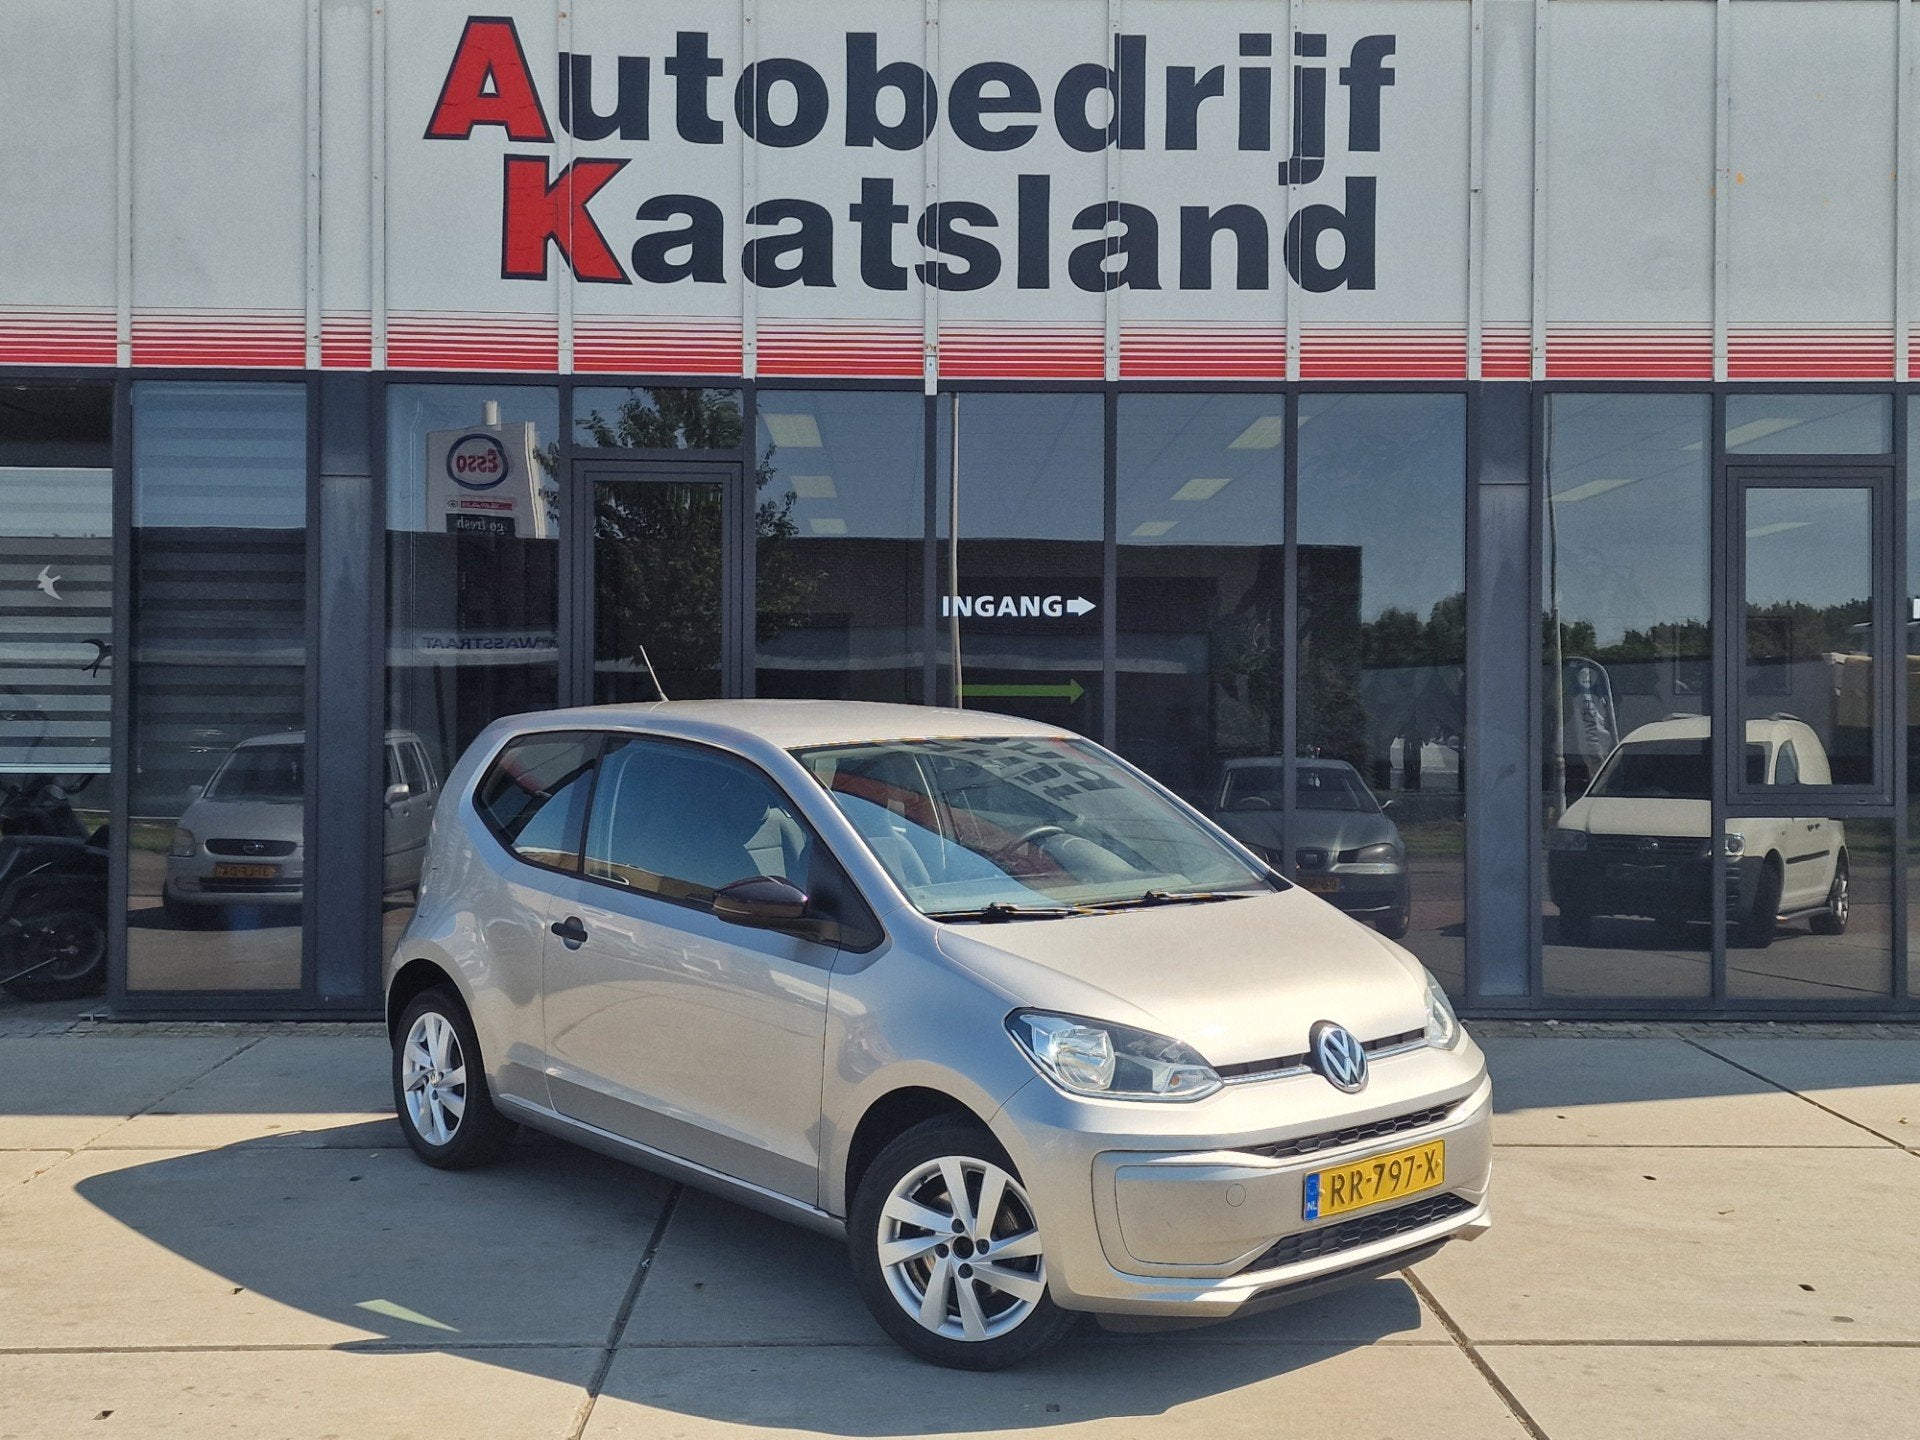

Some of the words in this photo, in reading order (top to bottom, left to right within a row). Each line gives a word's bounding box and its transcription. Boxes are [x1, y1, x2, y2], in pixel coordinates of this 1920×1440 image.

[423, 16, 1396, 186] Autobedrijf
[501, 153, 1377, 293] Kaatsland
[942, 595, 1063, 617] INGANG
[1306, 1200, 1318, 1212] NL
[1329, 1148, 1437, 1209] RR-797-X
